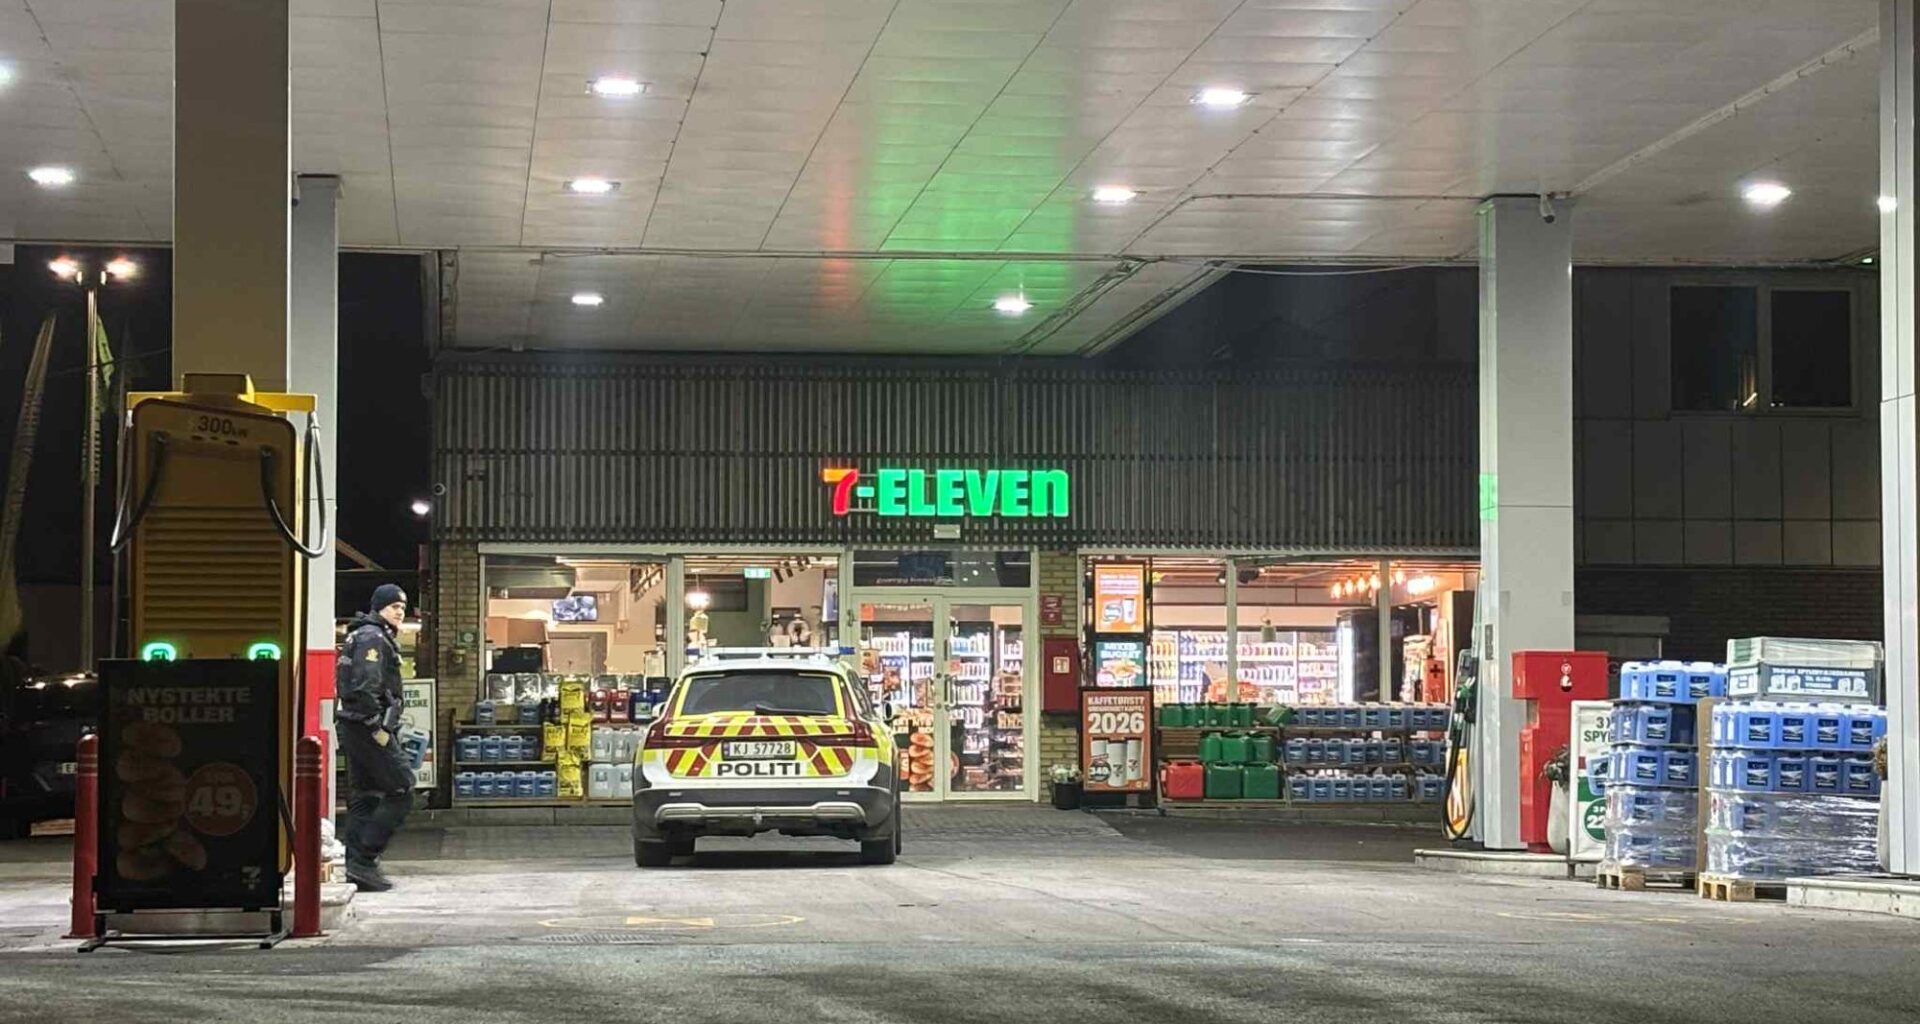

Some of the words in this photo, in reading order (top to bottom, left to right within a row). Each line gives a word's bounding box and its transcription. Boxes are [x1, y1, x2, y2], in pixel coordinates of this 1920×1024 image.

[127, 687, 251, 705] NYSTEKTE
[143, 706, 235, 724] BOLLER
[1088, 712, 1145, 734] 2026
[733, 743, 749, 755] KJ
[754, 743, 791, 755] 57728
[717, 762, 800, 776] POLITI
